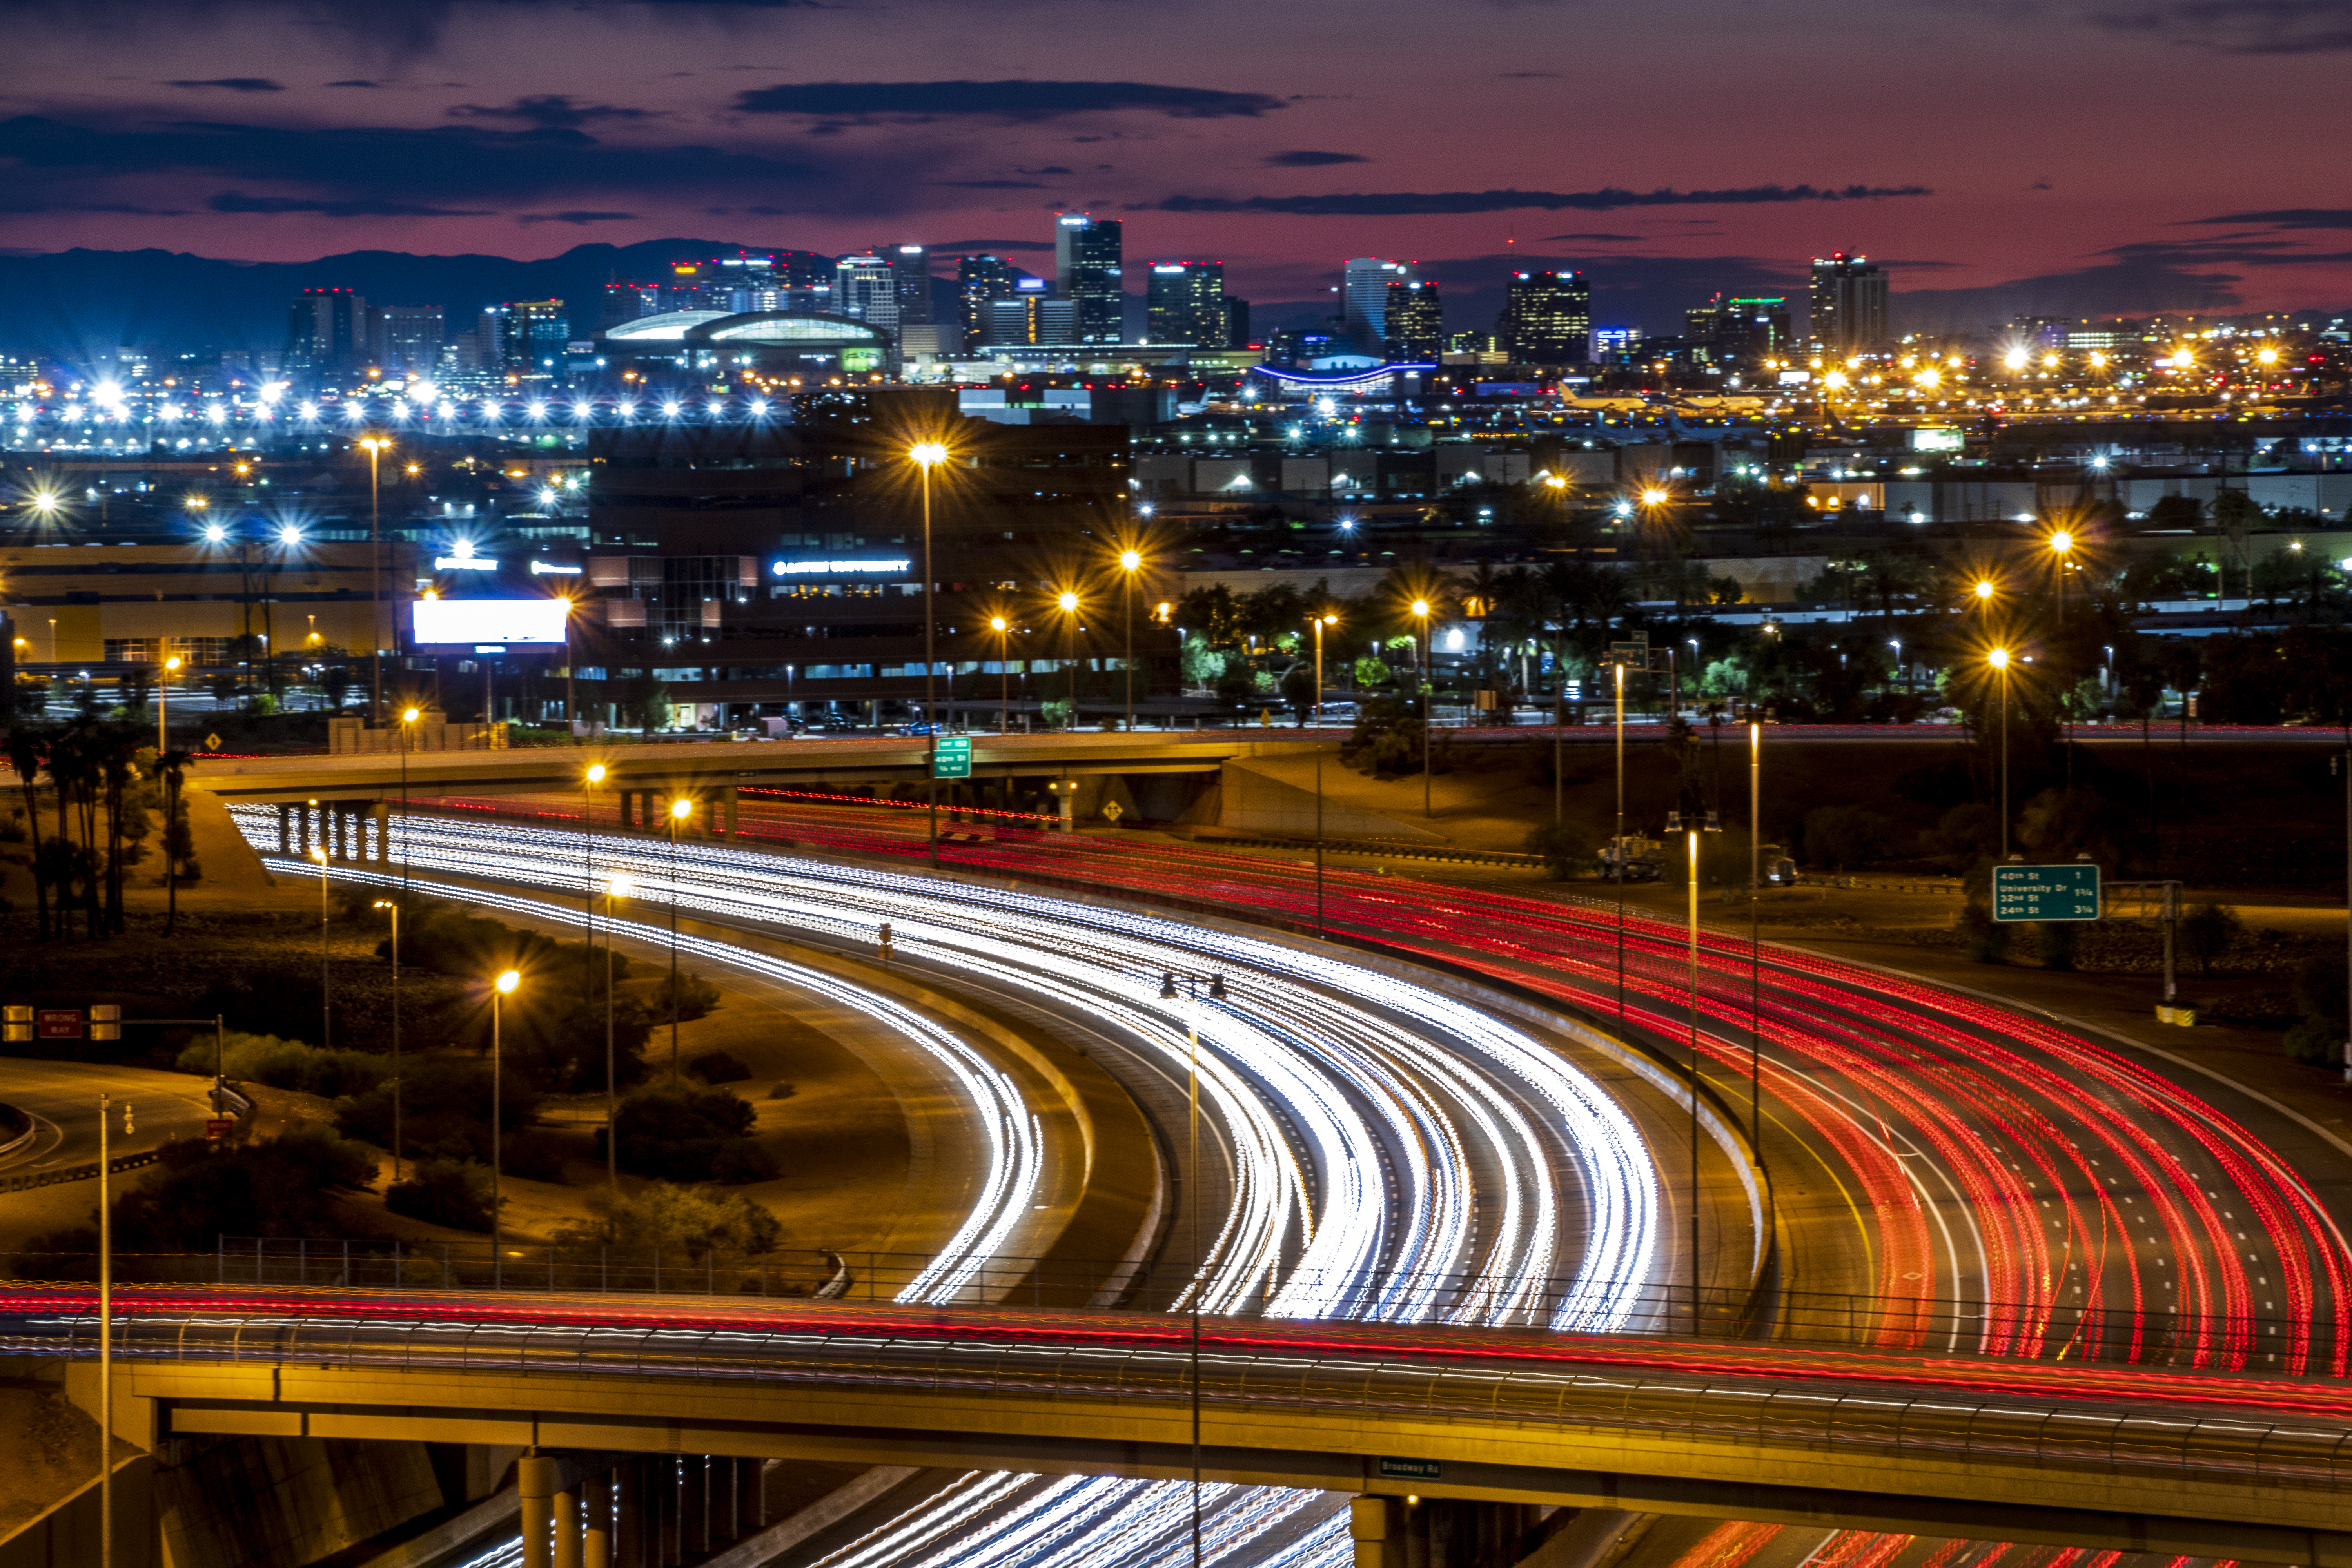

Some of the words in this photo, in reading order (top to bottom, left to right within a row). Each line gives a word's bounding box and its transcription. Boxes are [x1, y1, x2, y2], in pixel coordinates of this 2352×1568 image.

[2000, 885, 2052, 893] University
[44, 1014, 76, 1022] WRONG
[1382, 1461, 1424, 1474] Broadway
[1427, 1464, 1439, 1473] Rd
